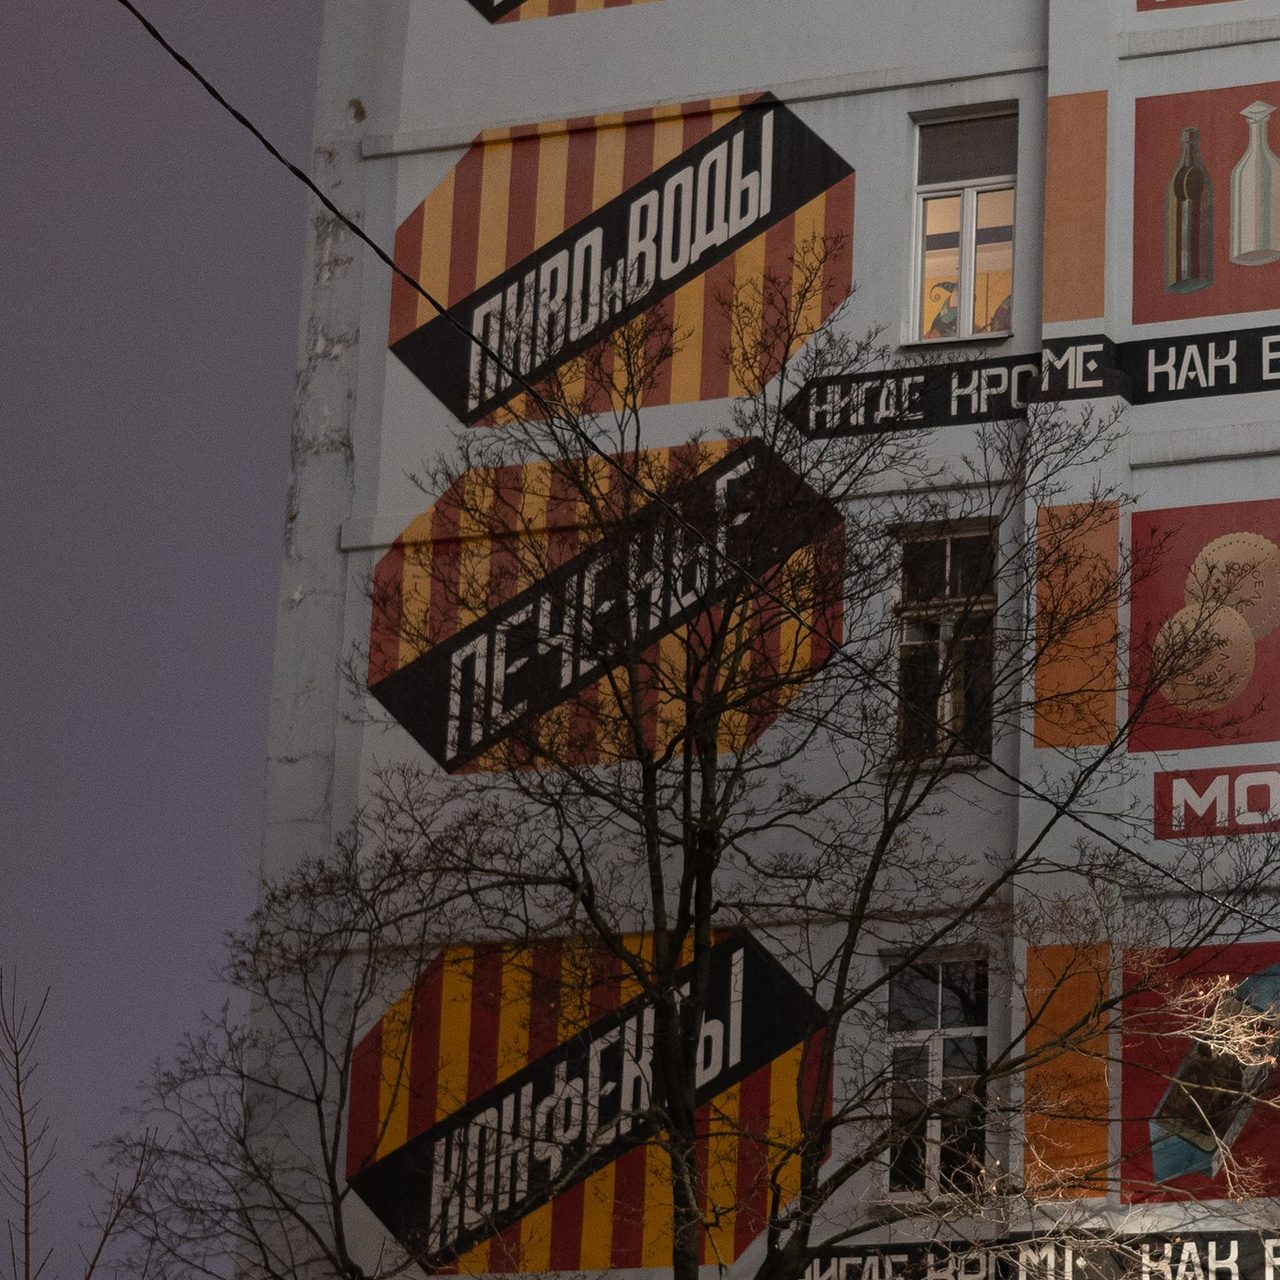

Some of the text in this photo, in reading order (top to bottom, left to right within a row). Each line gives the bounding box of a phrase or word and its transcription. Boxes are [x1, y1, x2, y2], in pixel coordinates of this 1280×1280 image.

[468, 226, 603, 413] ПИВО
[622, 110, 774, 306] ВОДЫ
[809, 376, 924, 431] НИГДЕ
[951, 344, 1103, 416] КРОМЕ
[1148, 337, 1236, 393] КАК
[428, 947, 745, 1256] КОНФЕКЫ
